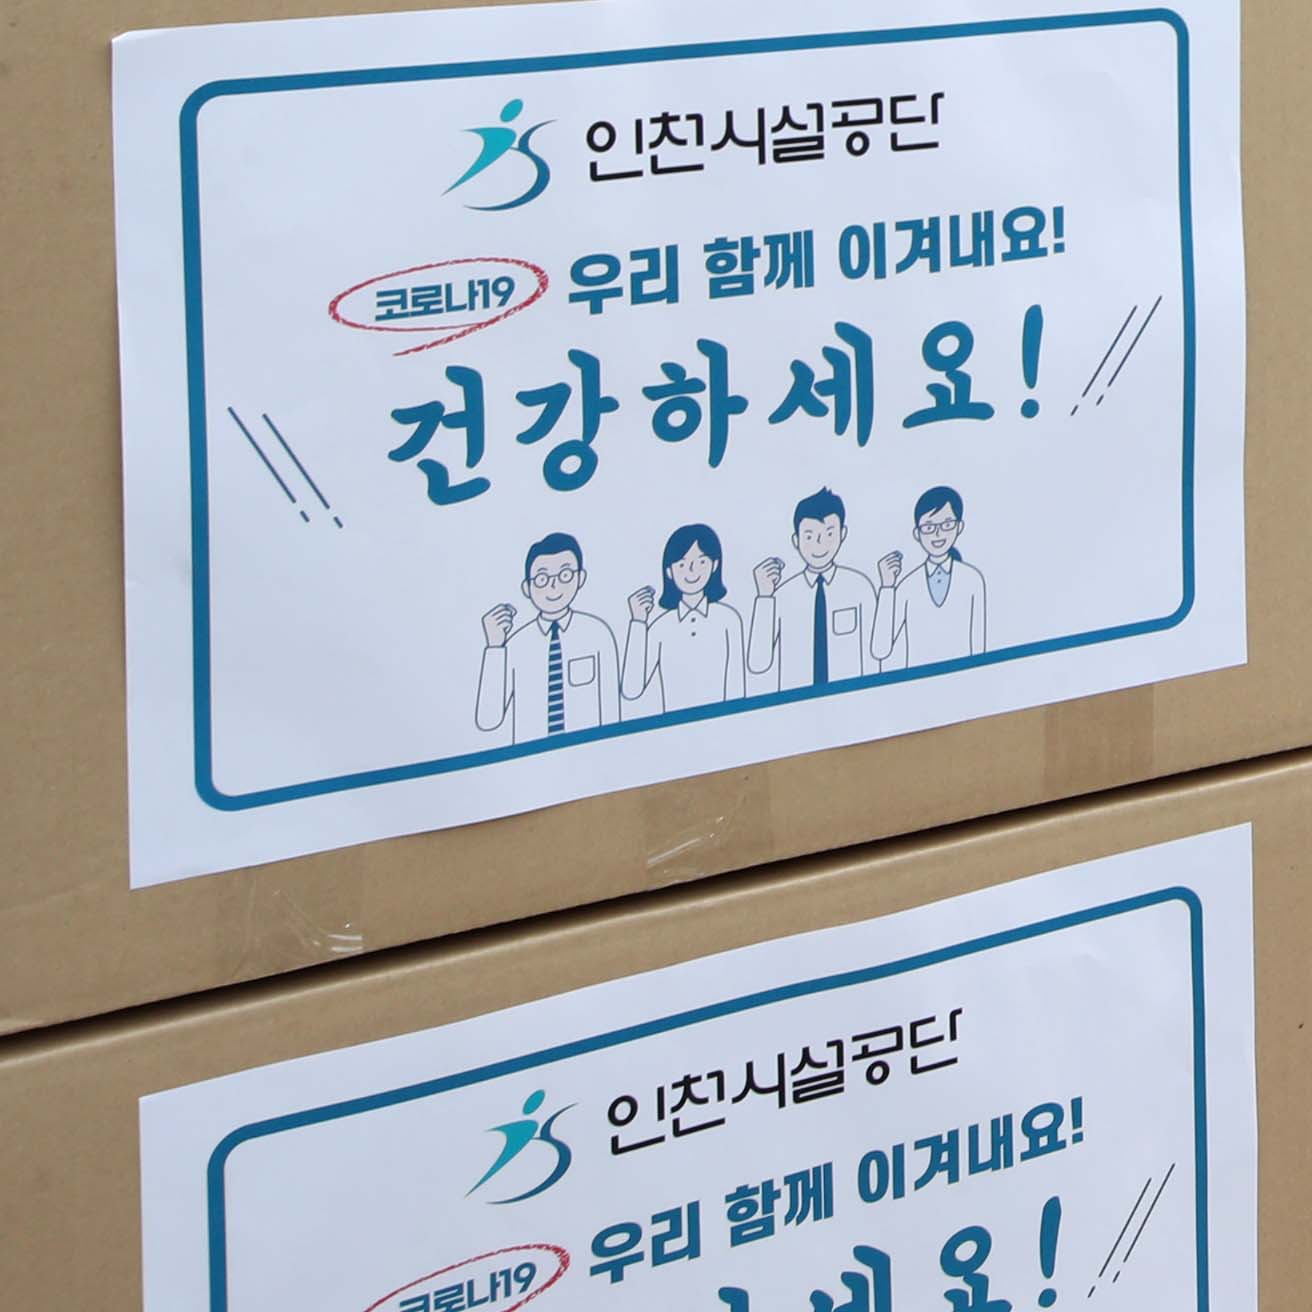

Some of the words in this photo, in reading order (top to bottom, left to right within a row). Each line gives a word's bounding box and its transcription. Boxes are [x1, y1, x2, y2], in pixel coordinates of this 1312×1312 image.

[585, 92, 945, 182] 인천시설공단
[373, 274, 516, 323] 코로나19
[566, 251, 680, 315] 우리
[703, 230, 815, 299] 함께
[838, 206, 1066, 283] 이겨내요!
[387, 304, 1043, 506] 건강하세요!
[606, 1008, 963, 1156] 인천시설공단
[588, 1202, 701, 1285] 우리
[725, 1161, 834, 1250] 함께
[856, 1097, 1085, 1204] 이겨내요!
